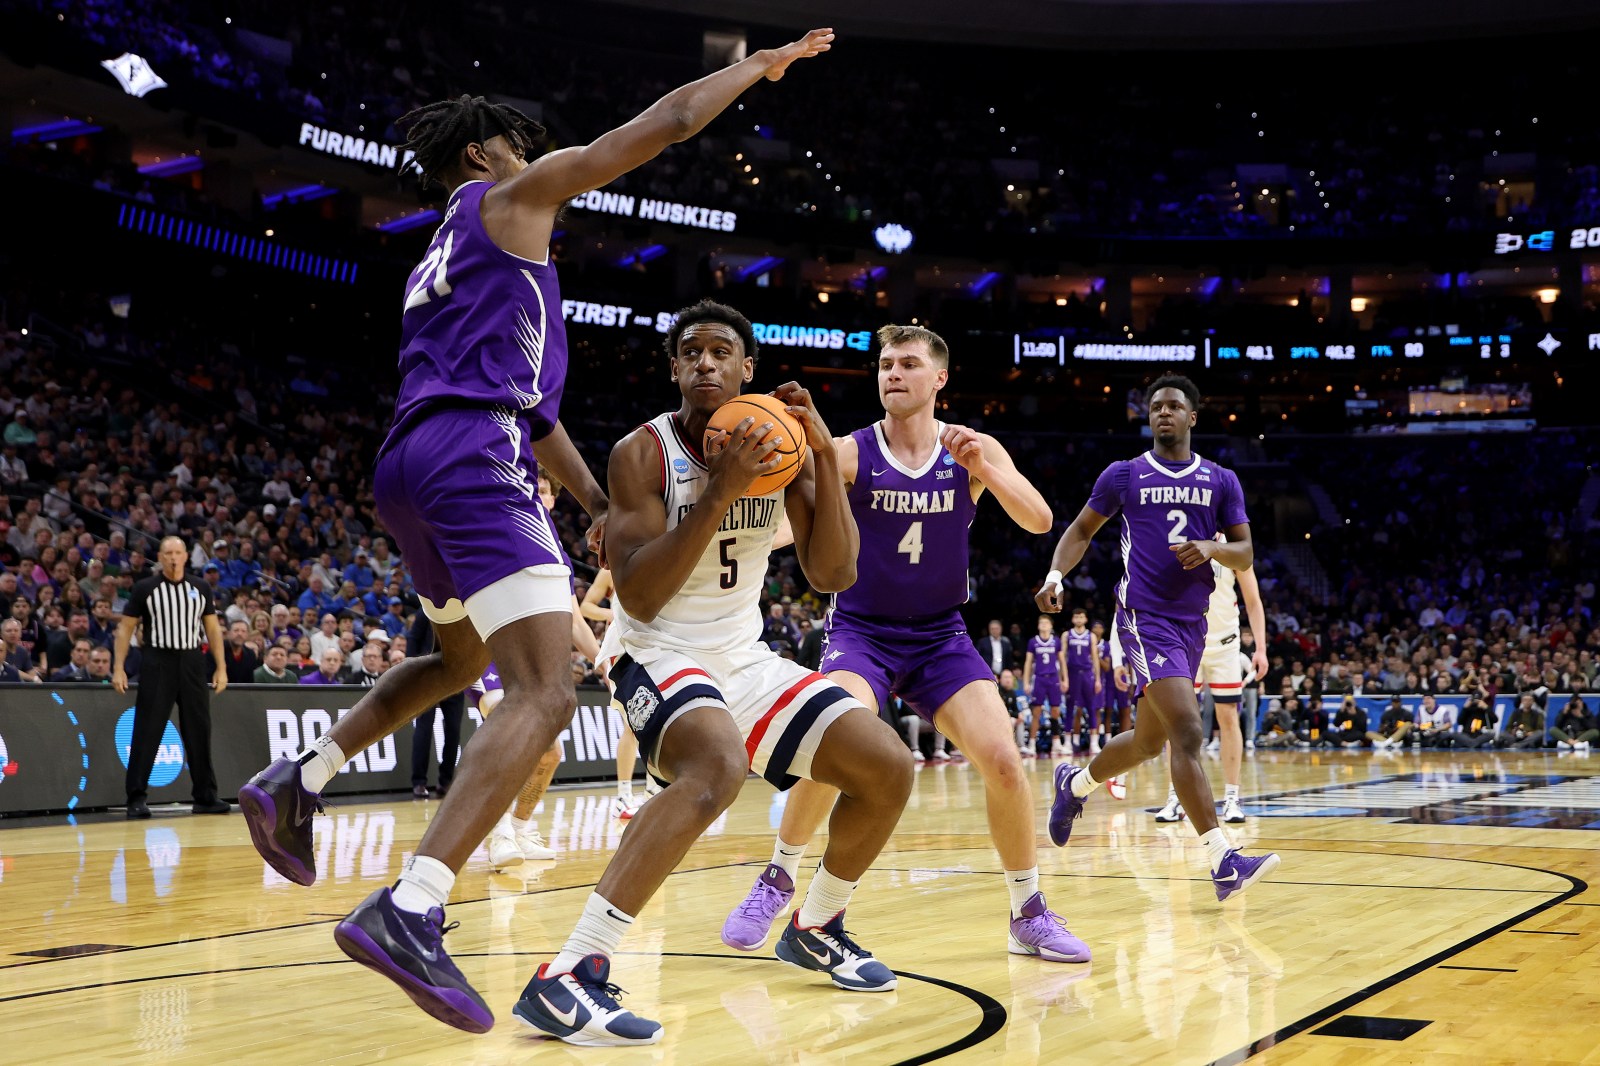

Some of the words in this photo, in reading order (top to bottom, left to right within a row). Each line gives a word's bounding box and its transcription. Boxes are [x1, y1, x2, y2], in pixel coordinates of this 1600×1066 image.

[299, 122, 397, 169] FURMAN
[638, 198, 737, 232] HUSKIES
[403, 229, 453, 314] 21
[561, 299, 632, 328] FIRST
[751, 322, 846, 349] ROUNDS
[1073, 343, 1196, 361] #MARCHMADNESS
[1480, 344, 1491, 358] 2
[1500, 343, 1510, 358] 3
[870, 488, 955, 514] FURMAN
[1140, 486, 1213, 507] FURMAN
[1166, 509, 1188, 544] 2
[897, 521, 924, 564] 4
[719, 537, 738, 590] 5
[1042, 652, 1050, 665] 3
